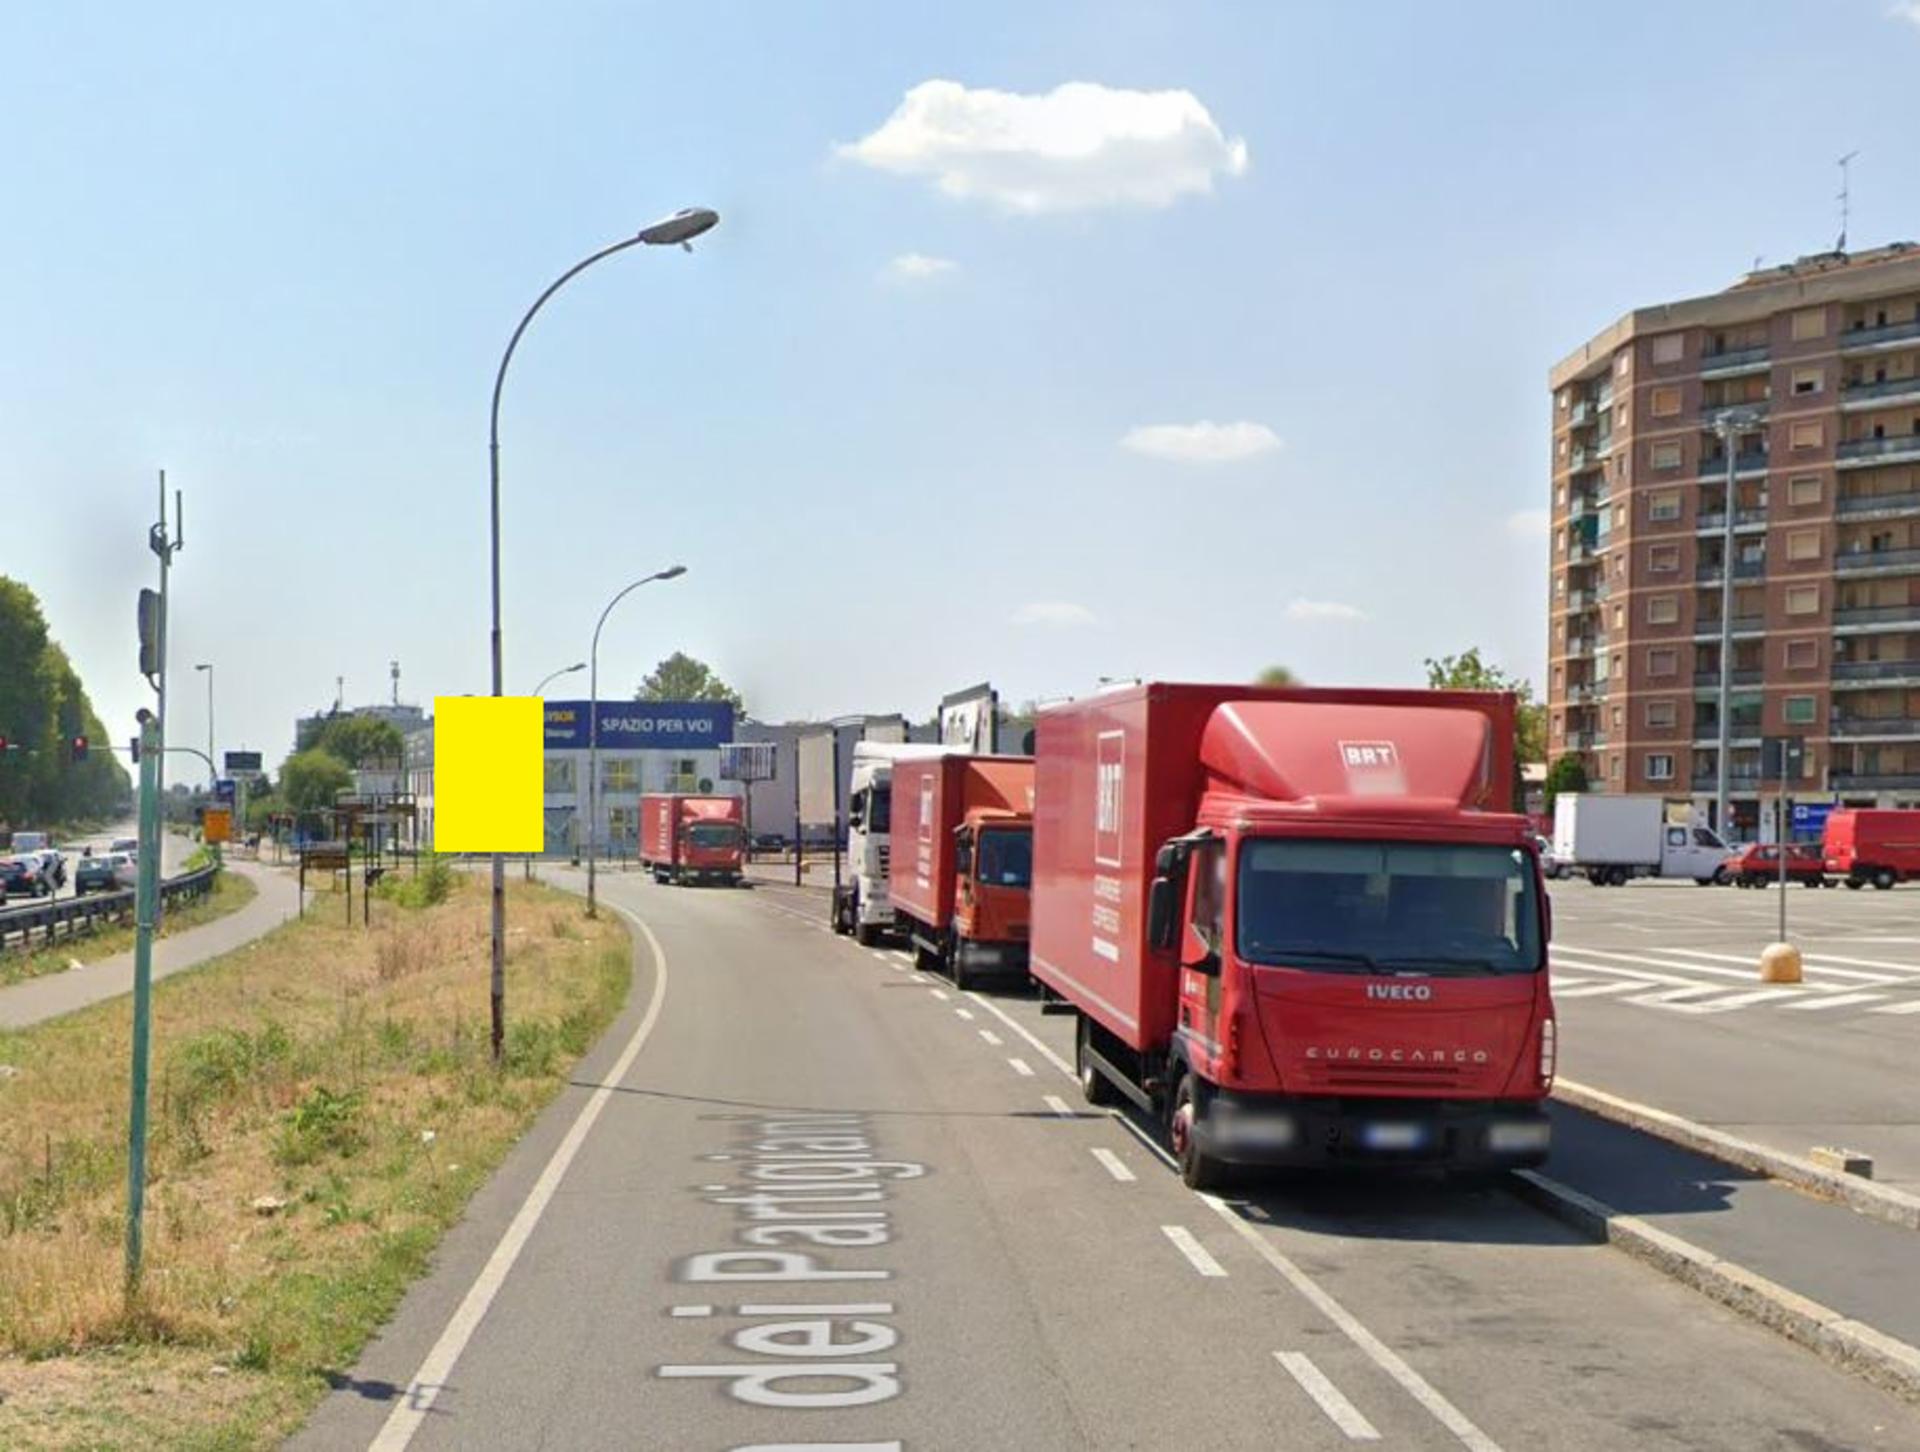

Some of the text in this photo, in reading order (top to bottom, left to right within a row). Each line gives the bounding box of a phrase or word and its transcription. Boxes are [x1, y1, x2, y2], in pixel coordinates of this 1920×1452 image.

[601, 718, 712, 735] SPAZIO PER VOI
[1346, 747, 1390, 766] BRT
[1367, 983, 1432, 1001] IVECO
[1306, 1047, 1488, 1063] EUROCARGO
